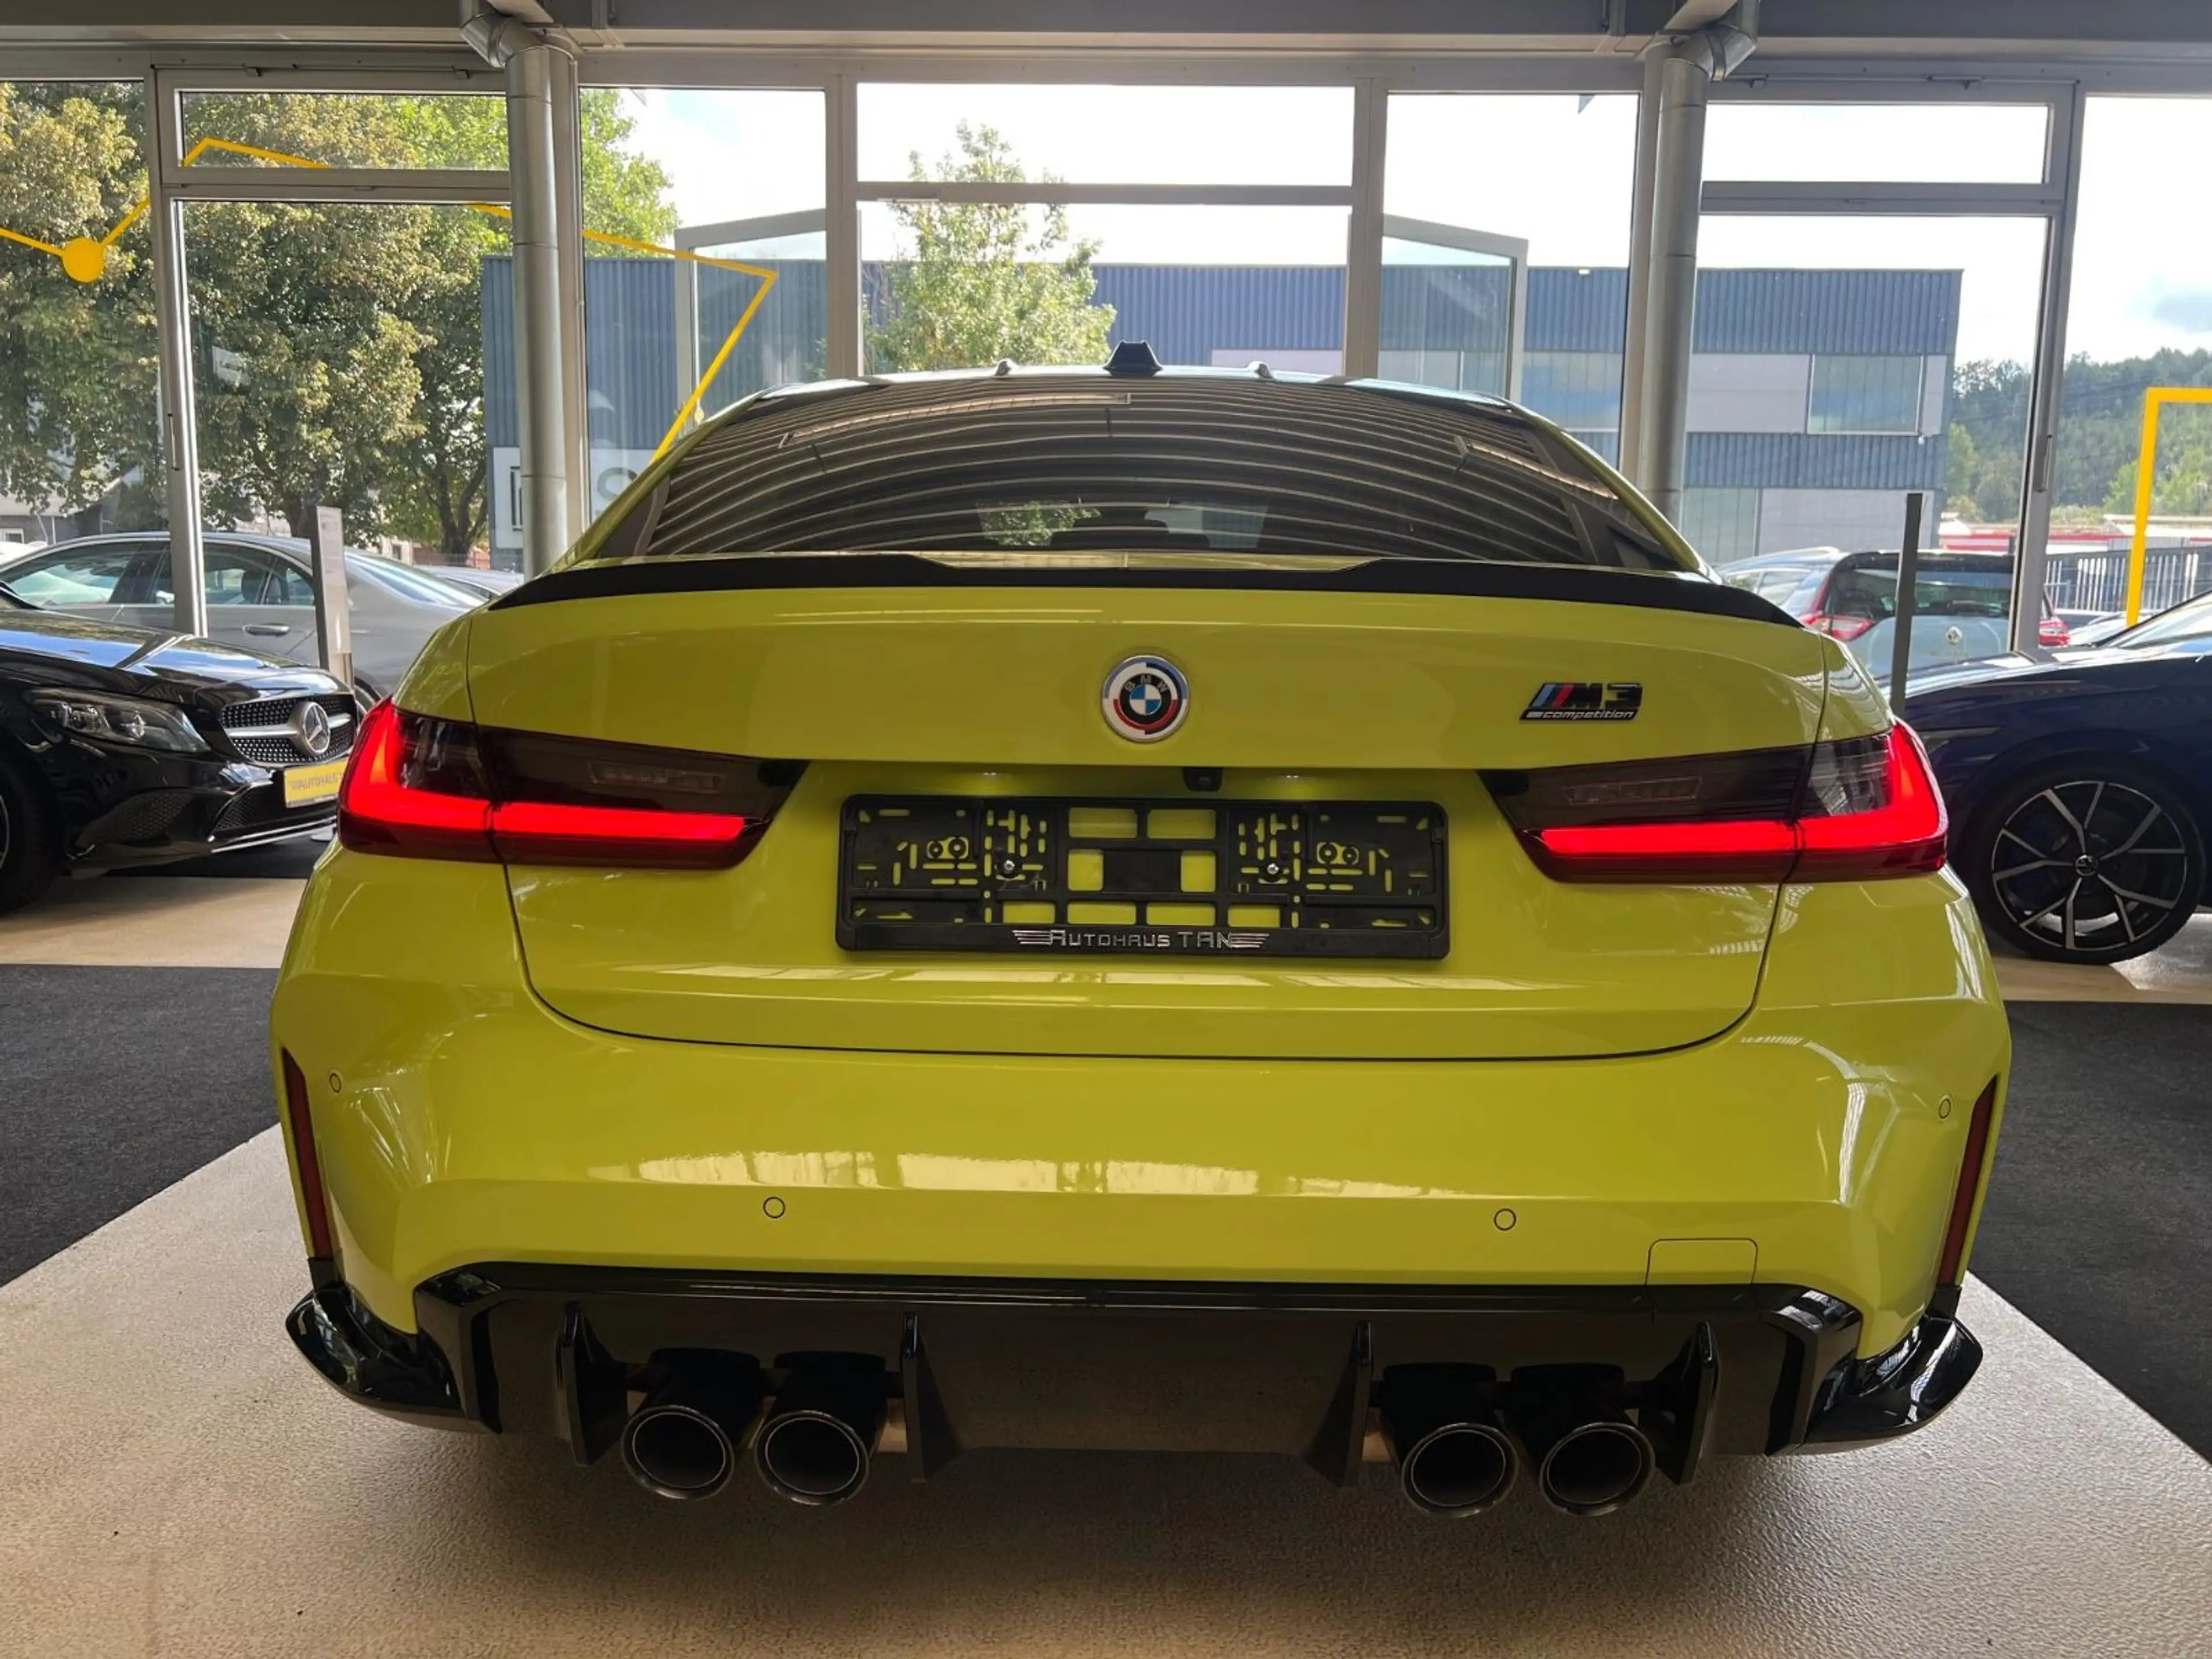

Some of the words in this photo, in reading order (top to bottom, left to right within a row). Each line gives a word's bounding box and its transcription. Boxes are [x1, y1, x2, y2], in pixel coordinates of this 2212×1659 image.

[1124, 675, 1169, 693] BMW
[1548, 683, 1643, 709] M3
[1543, 710, 1634, 719] competition
[1050, 929, 1171, 947] AUTOHAUS
[1177, 931, 1232, 948] TAN
